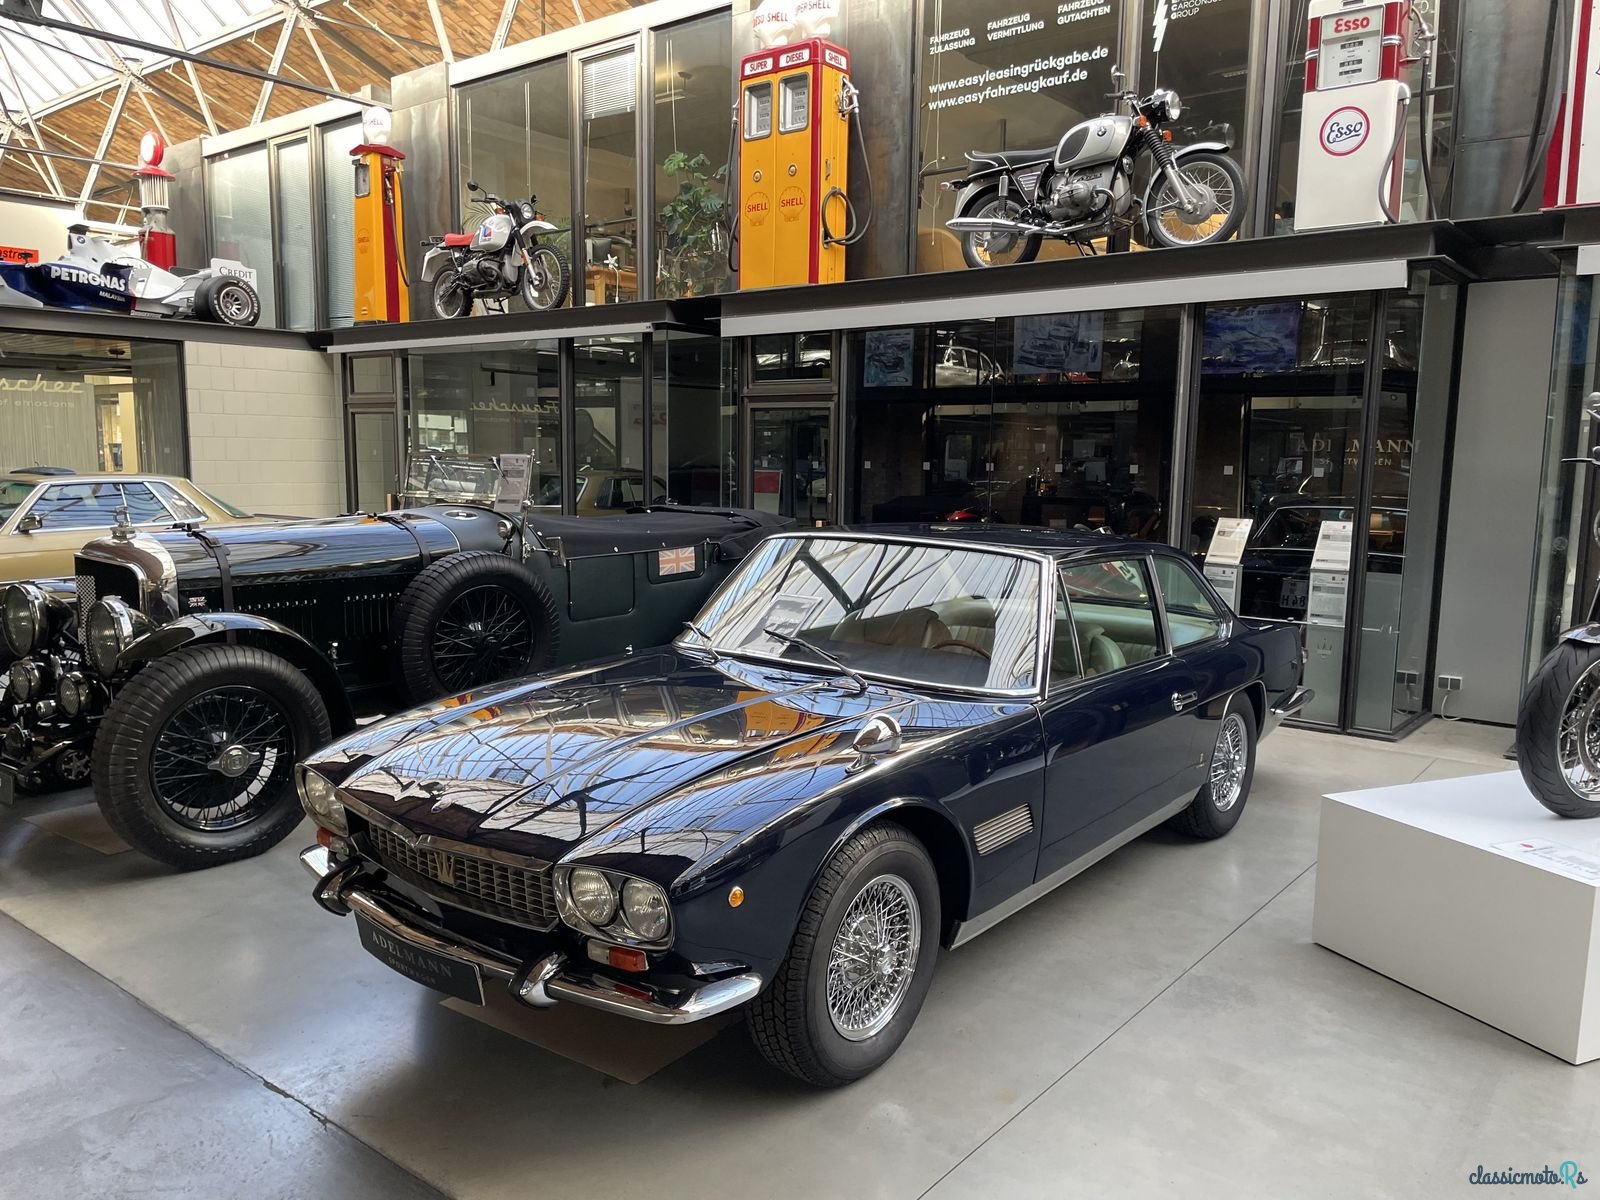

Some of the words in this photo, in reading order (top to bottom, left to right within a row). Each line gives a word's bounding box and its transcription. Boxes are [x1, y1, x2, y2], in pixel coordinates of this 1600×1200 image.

[767, 12, 788, 23] SHELL
[987, 13, 1030, 31] FAHRZEUG
[1056, 5, 1111, 25] GUTACHTEN
[1170, 7, 1200, 20] GROUP
[929, 28, 970, 45] FAHRZEUG
[987, 20, 1045, 42] VERMITTLUNG
[929, 37, 976, 55] ZULASSUNG
[749, 60, 768, 72] SUPER
[785, 52, 805, 64] DIESEL
[828, 53, 843, 66] SHELL
[928, 46, 1109, 94] www.easyleasingrückgabe.de
[928, 68, 1088, 111] www.easyfahrzeugkauf.de
[1326, 121, 1363, 145] Esso
[746, 203, 768, 213] SHELL
[780, 198, 803, 208] SHELL
[50, 265, 126, 292] PETRONAS
[219, 266, 253, 279] CREDIT
[372, 931, 452, 977] ADELMANN
